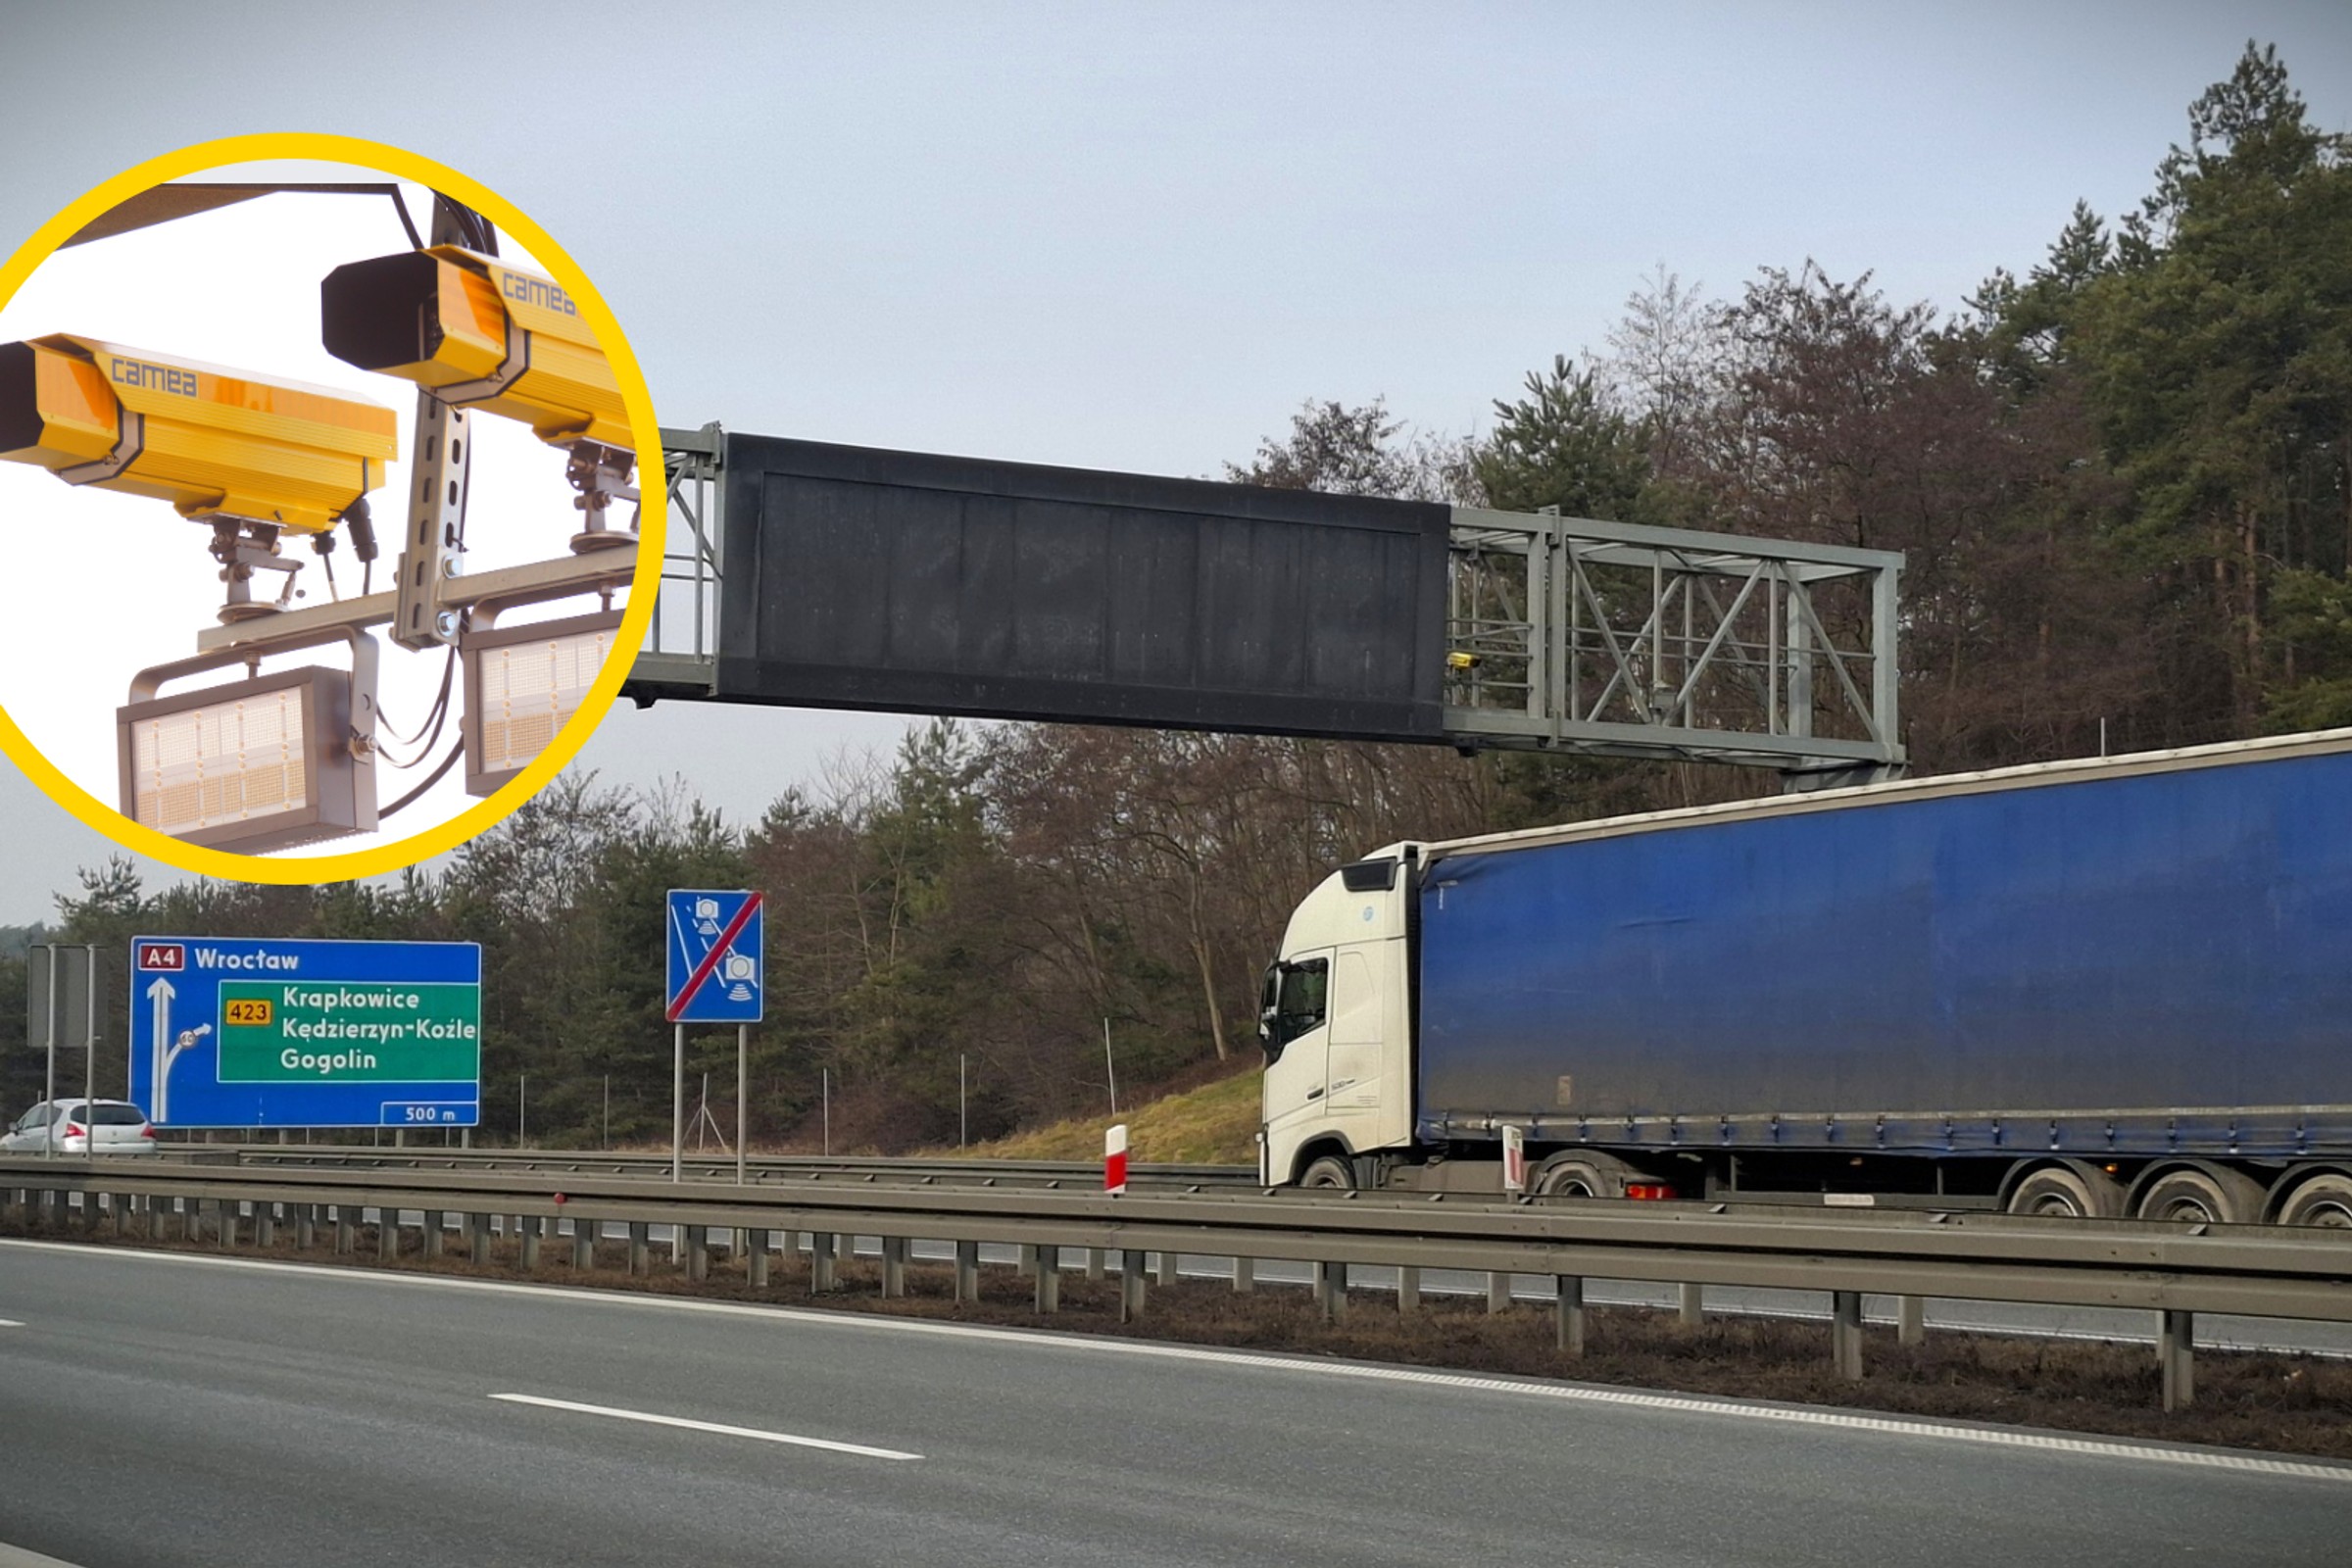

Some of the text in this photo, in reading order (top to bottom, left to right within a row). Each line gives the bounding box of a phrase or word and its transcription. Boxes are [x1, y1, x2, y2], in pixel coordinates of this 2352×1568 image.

[112, 358, 197, 397] camea
[147, 948, 175, 965] A4
[194, 948, 299, 969] Wrocław
[283, 986, 419, 1013] Krapkowice
[230, 1004, 267, 1020] 423
[282, 1017, 476, 1044] Kędzierzyn-Koźle
[280, 1048, 376, 1074] Gogolin
[405, 1106, 455, 1121] 500 m
